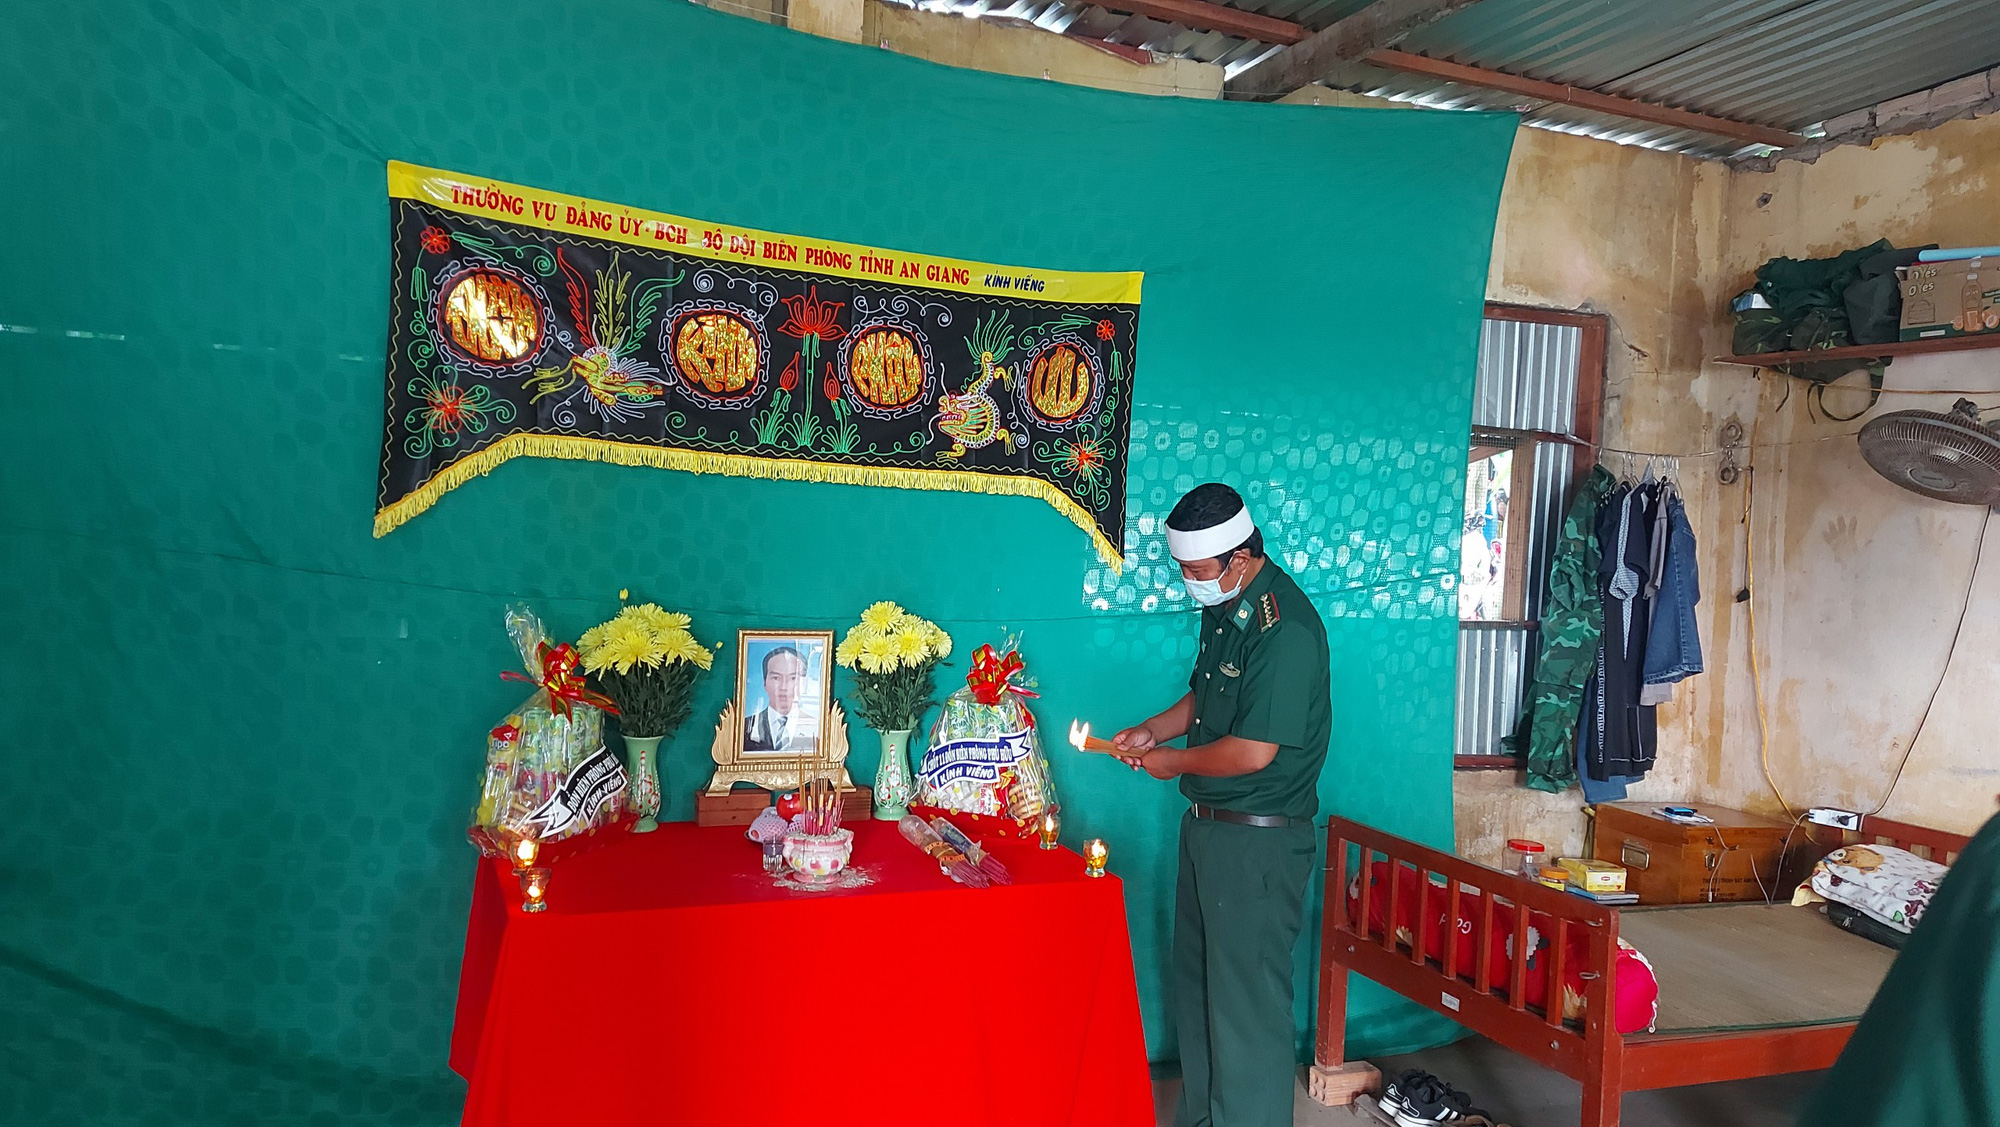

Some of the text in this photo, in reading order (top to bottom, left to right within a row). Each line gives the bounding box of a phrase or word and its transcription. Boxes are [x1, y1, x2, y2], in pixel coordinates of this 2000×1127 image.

[451, 184, 524, 216] THƯỜNG
[531, 200, 558, 226] VỤ
[565, 201, 613, 232] ĐẢNG
[619, 208, 644, 237] ỦY
[654, 222, 688, 245] BCH
[702, 228, 724, 256] BỘ
[729, 233, 756, 261] ĐỘI
[762, 238, 798, 263] BIÊN
[805, 246, 853, 271] PHÒNG
[858, 248, 895, 276] TỈNH
[899, 261, 921, 280] AN
[926, 264, 970, 286] GIANG
[984, 269, 1011, 289] KÍNH
[1014, 273, 1045, 293] VIẾNG
[940, 766, 963, 785] KÍNH
